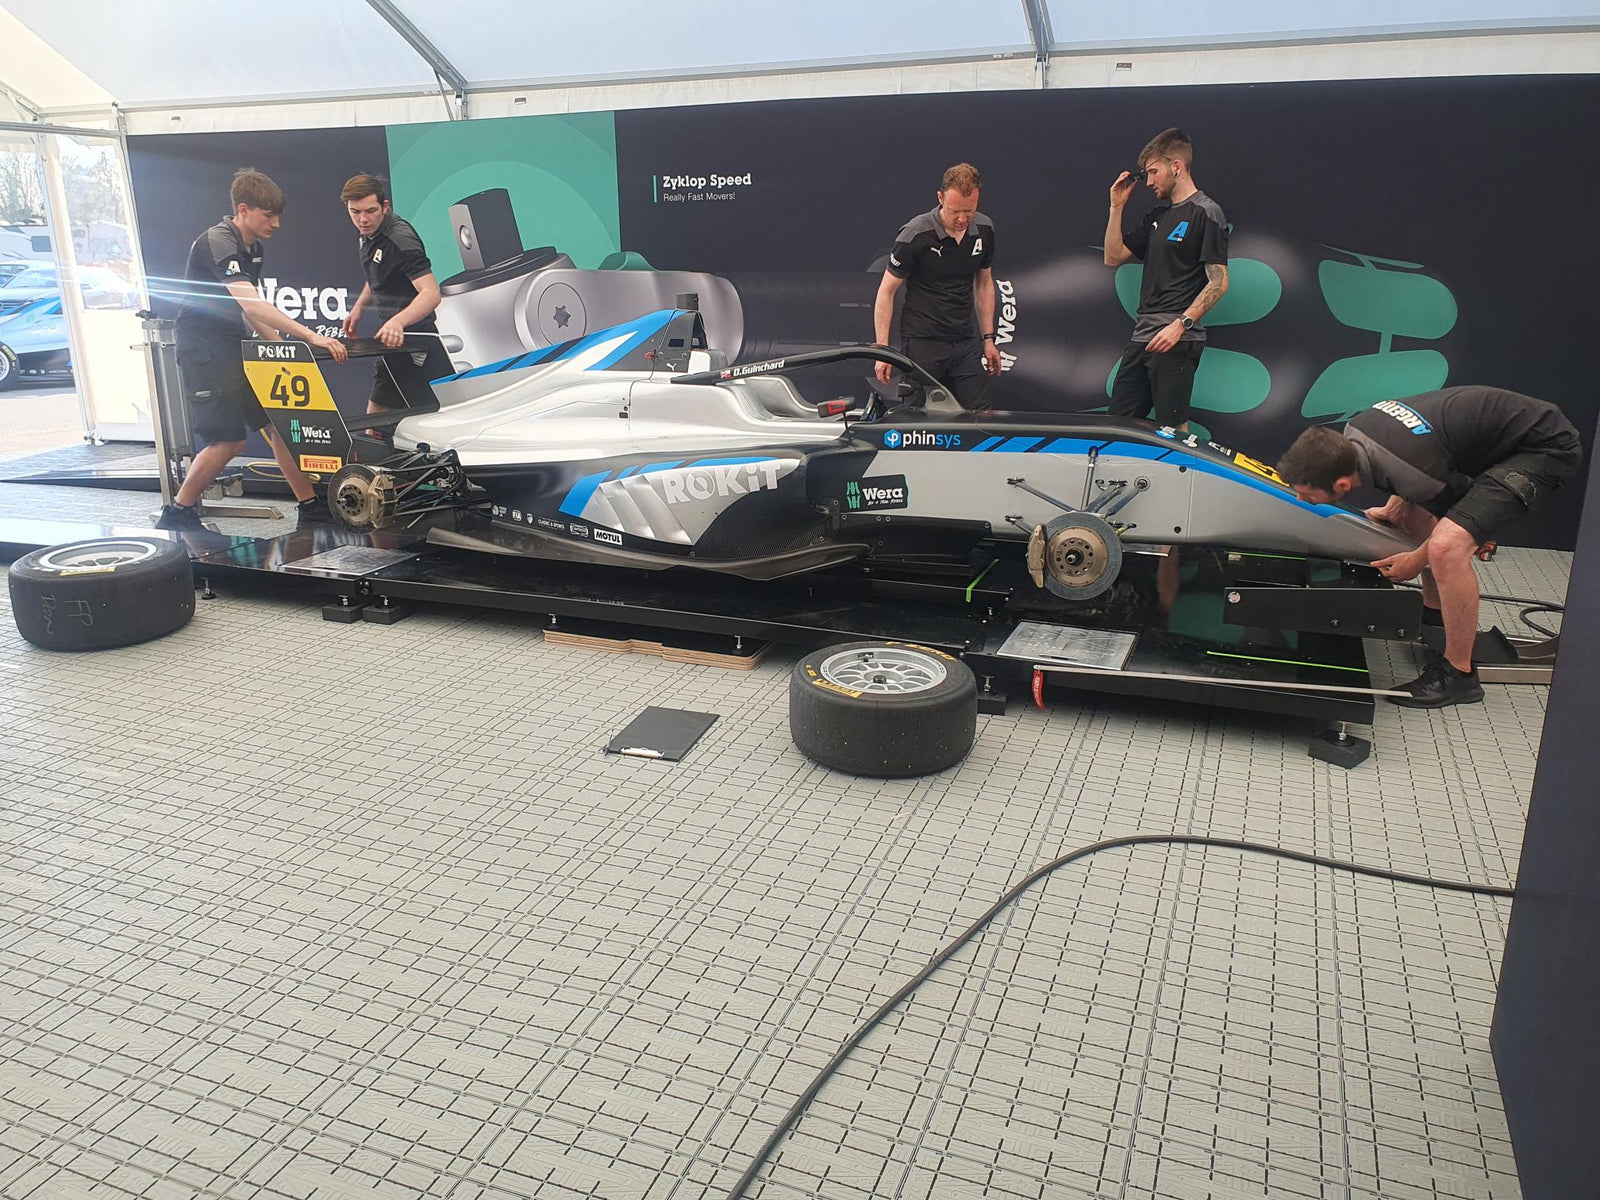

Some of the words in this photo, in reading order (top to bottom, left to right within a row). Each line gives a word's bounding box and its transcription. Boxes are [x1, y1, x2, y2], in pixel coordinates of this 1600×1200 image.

[663, 175, 707, 190] Zyklop
[710, 173, 752, 188] Speed
[663, 193, 685, 203] Really
[687, 193, 704, 201] Fast
[706, 192, 736, 201] Movers!
[995, 279, 1017, 346] Wera
[270, 374, 310, 407] 49
[301, 426, 331, 439] Wera
[902, 430, 961, 448] phinsys
[303, 457, 338, 470] PIRELLI
[862, 487, 904, 501] Wera
[595, 531, 620, 543] MOTUL
